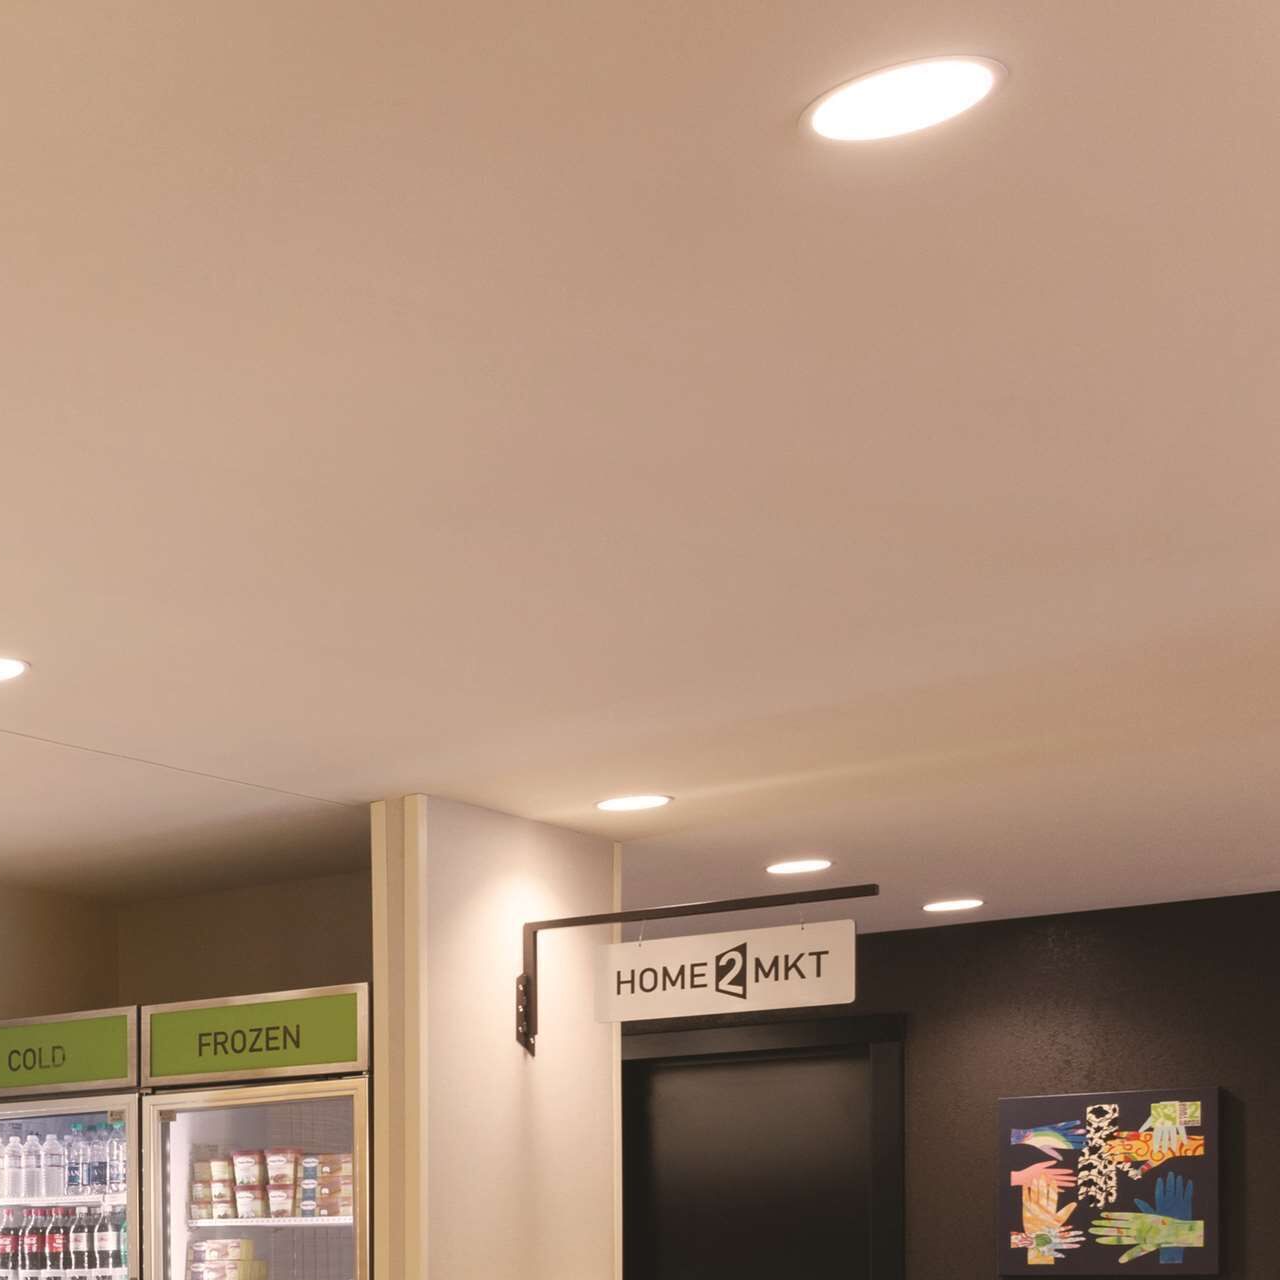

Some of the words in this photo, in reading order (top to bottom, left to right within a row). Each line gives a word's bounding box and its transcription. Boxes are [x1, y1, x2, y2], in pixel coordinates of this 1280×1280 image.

[616, 962, 708, 995] HOME
[754, 951, 830, 984] MKT
[197, 1025, 301, 1057] FROZEN
[8, 1046, 66, 1072] COLD
